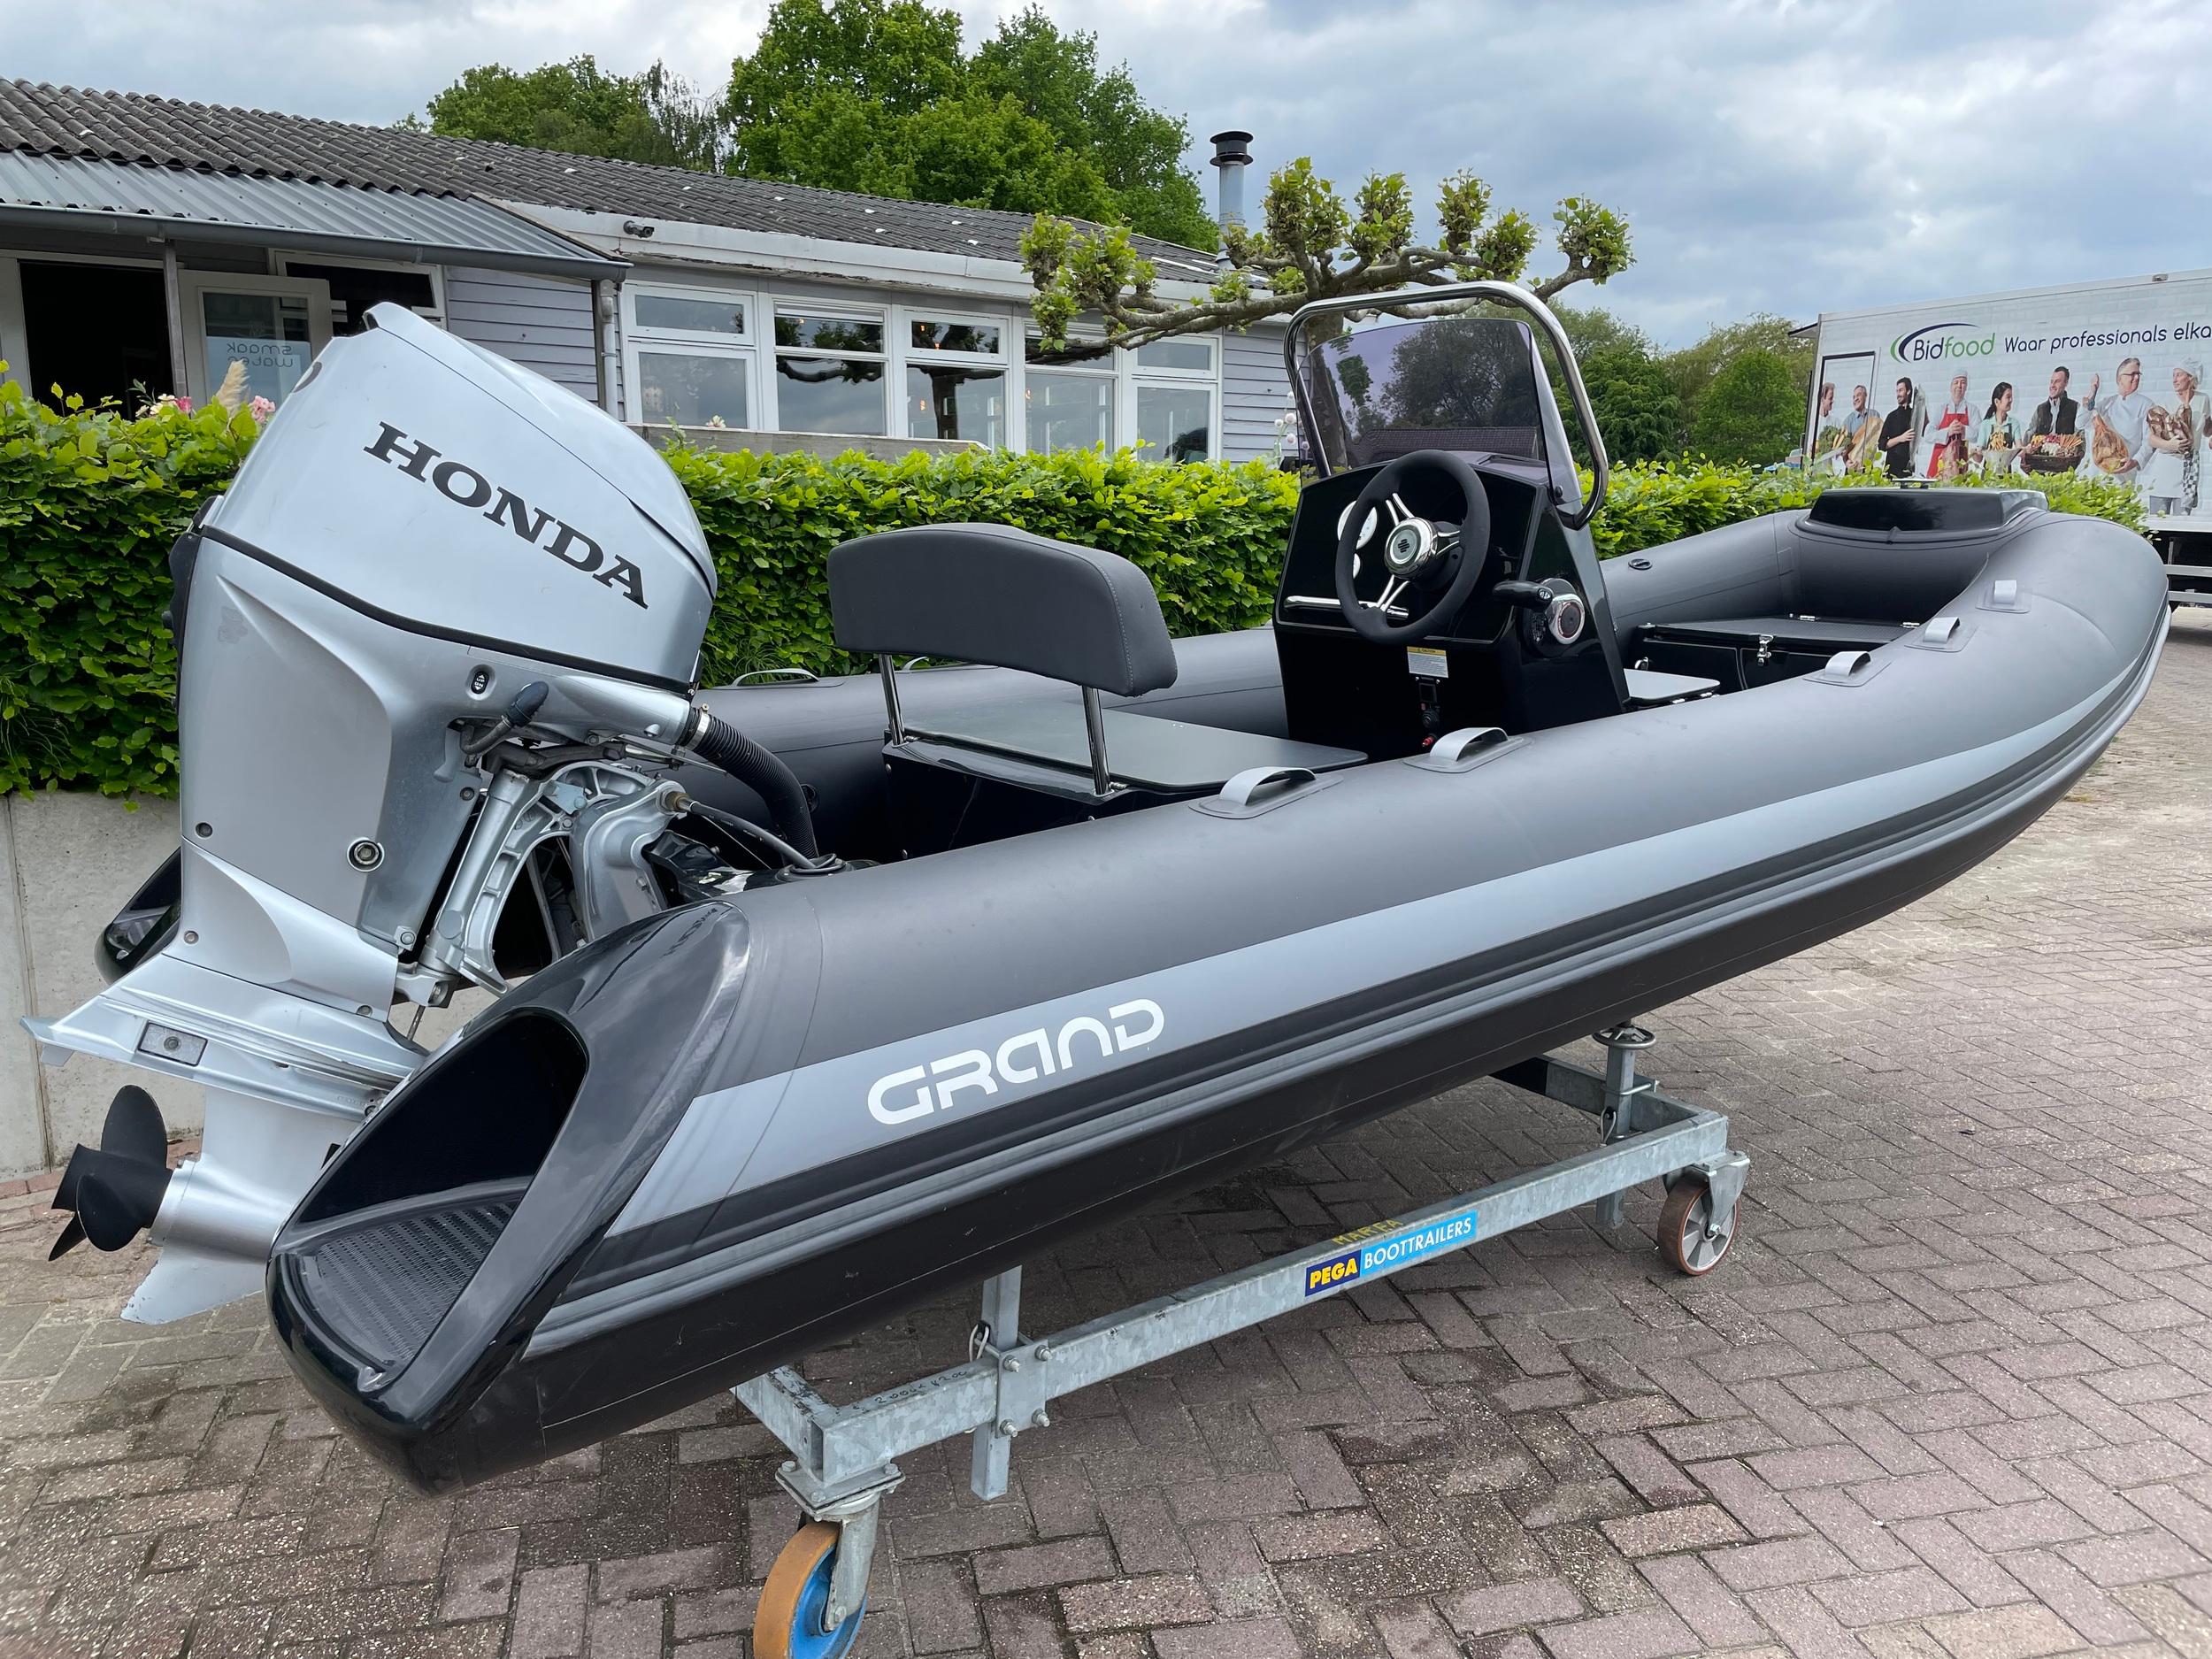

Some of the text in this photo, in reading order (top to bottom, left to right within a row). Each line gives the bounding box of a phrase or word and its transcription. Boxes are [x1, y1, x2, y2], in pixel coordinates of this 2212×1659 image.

[1913, 332, 1995, 361] Bidfood
[2005, 321, 2212, 354] Waar professionals elka
[363, 421, 649, 610] HONDA
[867, 998, 1164, 1125] GRAND
[1310, 1217, 1471, 1289] PEGA BOOTTRAILERS
